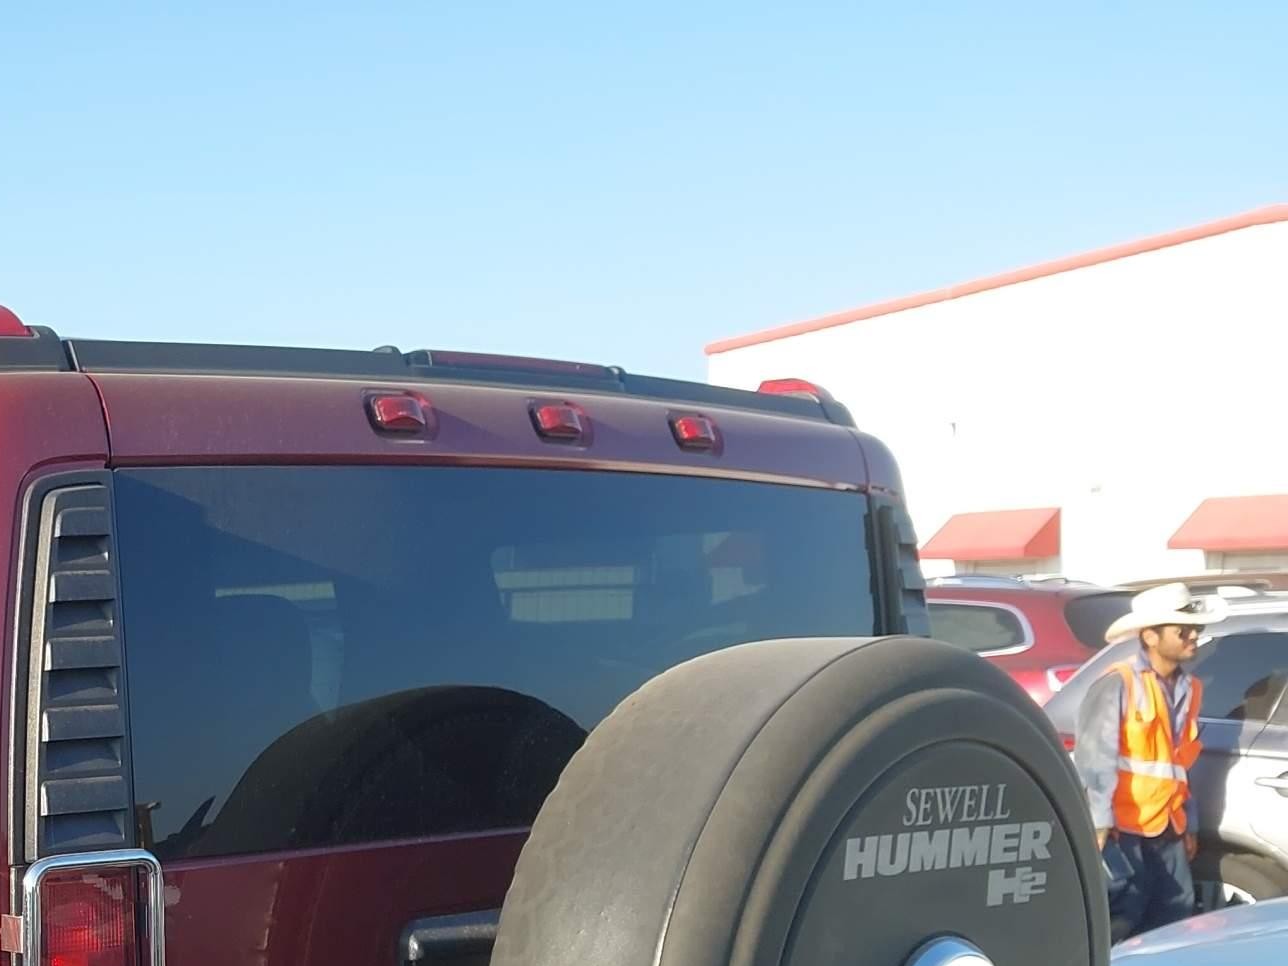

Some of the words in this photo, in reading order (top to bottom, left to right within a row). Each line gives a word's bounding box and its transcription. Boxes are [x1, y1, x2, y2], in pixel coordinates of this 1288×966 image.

[903, 784, 1010, 826] SEWELL
[843, 821, 1052, 880] HUMMER
[987, 867, 1046, 907] H2
